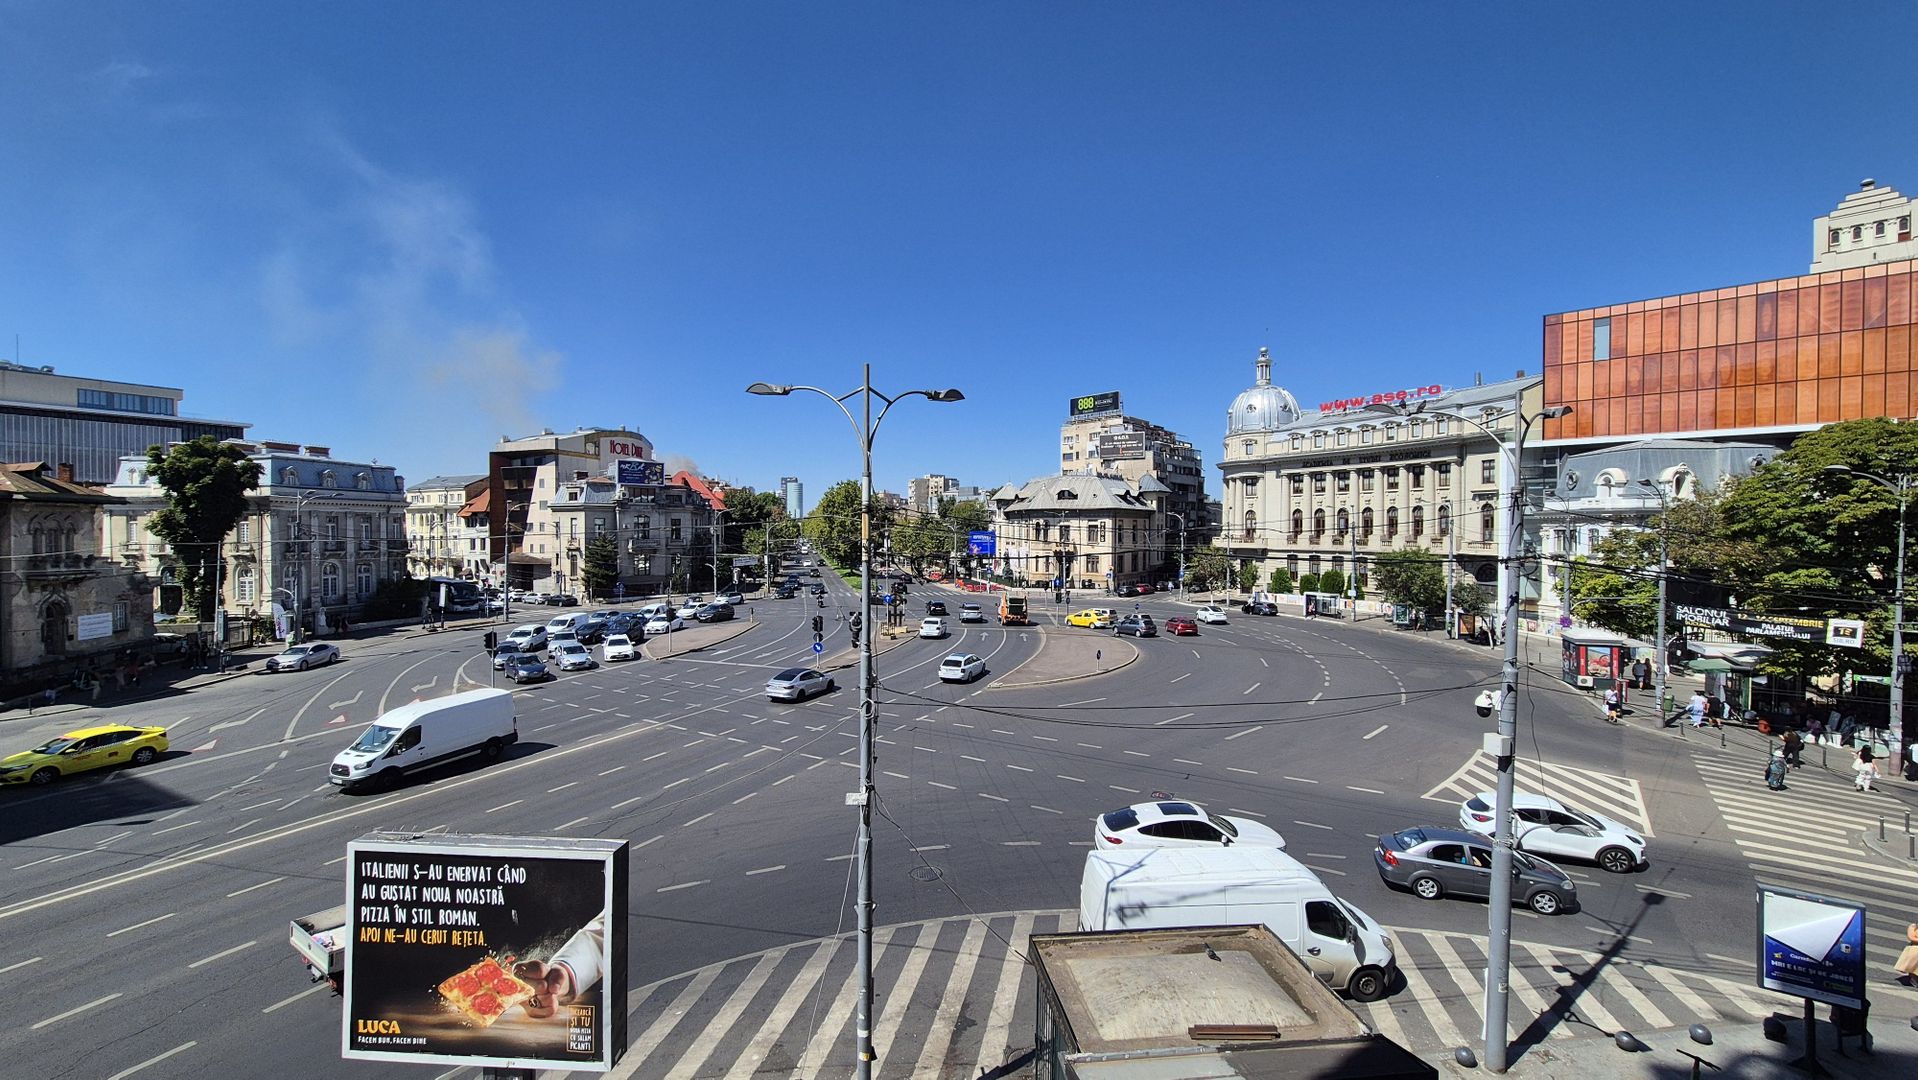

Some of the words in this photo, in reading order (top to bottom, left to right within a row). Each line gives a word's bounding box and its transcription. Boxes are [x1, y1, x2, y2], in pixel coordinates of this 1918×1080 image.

[1078, 396, 1094, 410] 888
[1320, 385, 1441, 411] www.ase.ro
[610, 440, 630, 456] HOTEL
[1676, 605, 1731, 620] SALONUL
[1676, 613, 1730, 627] IMOBILIAR
[1745, 627, 1811, 639] PARLAMENTULUI
[1761, 623, 1795, 633] PALATUL
[362, 862, 409, 879] ITALIENII
[447, 866, 492, 882] ENERVAT
[497, 864, 526, 884] CÂND
[361, 883, 376, 899] AU
[380, 885, 417, 901] GUSTAT
[422, 886, 451, 903] NOUA
[456, 886, 505, 905] NOASTRĂ
[361, 906, 390, 923] PIZZA
[394, 904, 407, 923] ÎN
[412, 908, 434, 925] STIL
[438, 909, 480, 926] ROMAN.
[360, 927, 381, 942] APOI
[421, 929, 448, 945] CERUT
[451, 930, 487, 948] REȚETA.
[358, 1019, 401, 1034] LUCA
[581, 1017, 590, 1027] TU
[358, 1036, 377, 1044] FACEM
[413, 1037, 427, 1045] BINE
